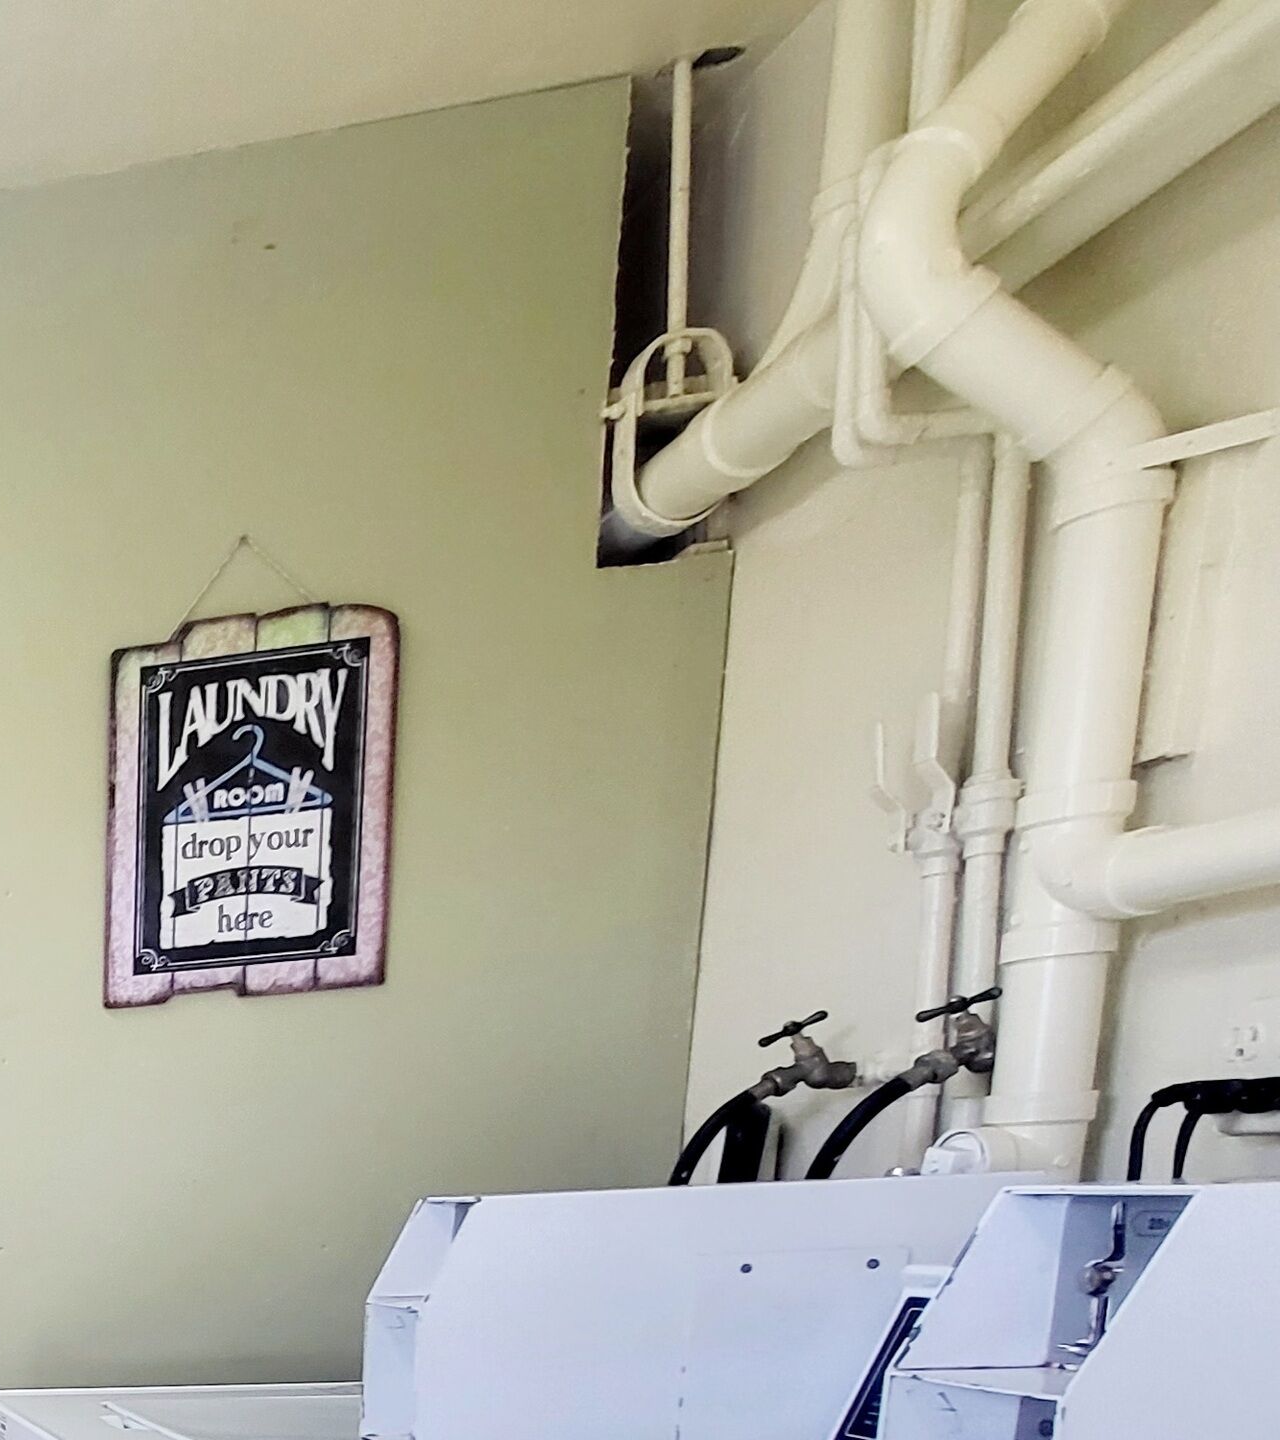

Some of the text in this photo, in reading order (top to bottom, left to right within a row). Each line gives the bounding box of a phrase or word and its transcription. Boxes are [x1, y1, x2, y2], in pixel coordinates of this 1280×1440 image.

[156, 667, 348, 792] LAUNDRY
[213, 782, 285, 809] ROOM
[181, 825, 314, 861] drop your
[192, 867, 298, 901] PANTS
[217, 904, 273, 934] here
